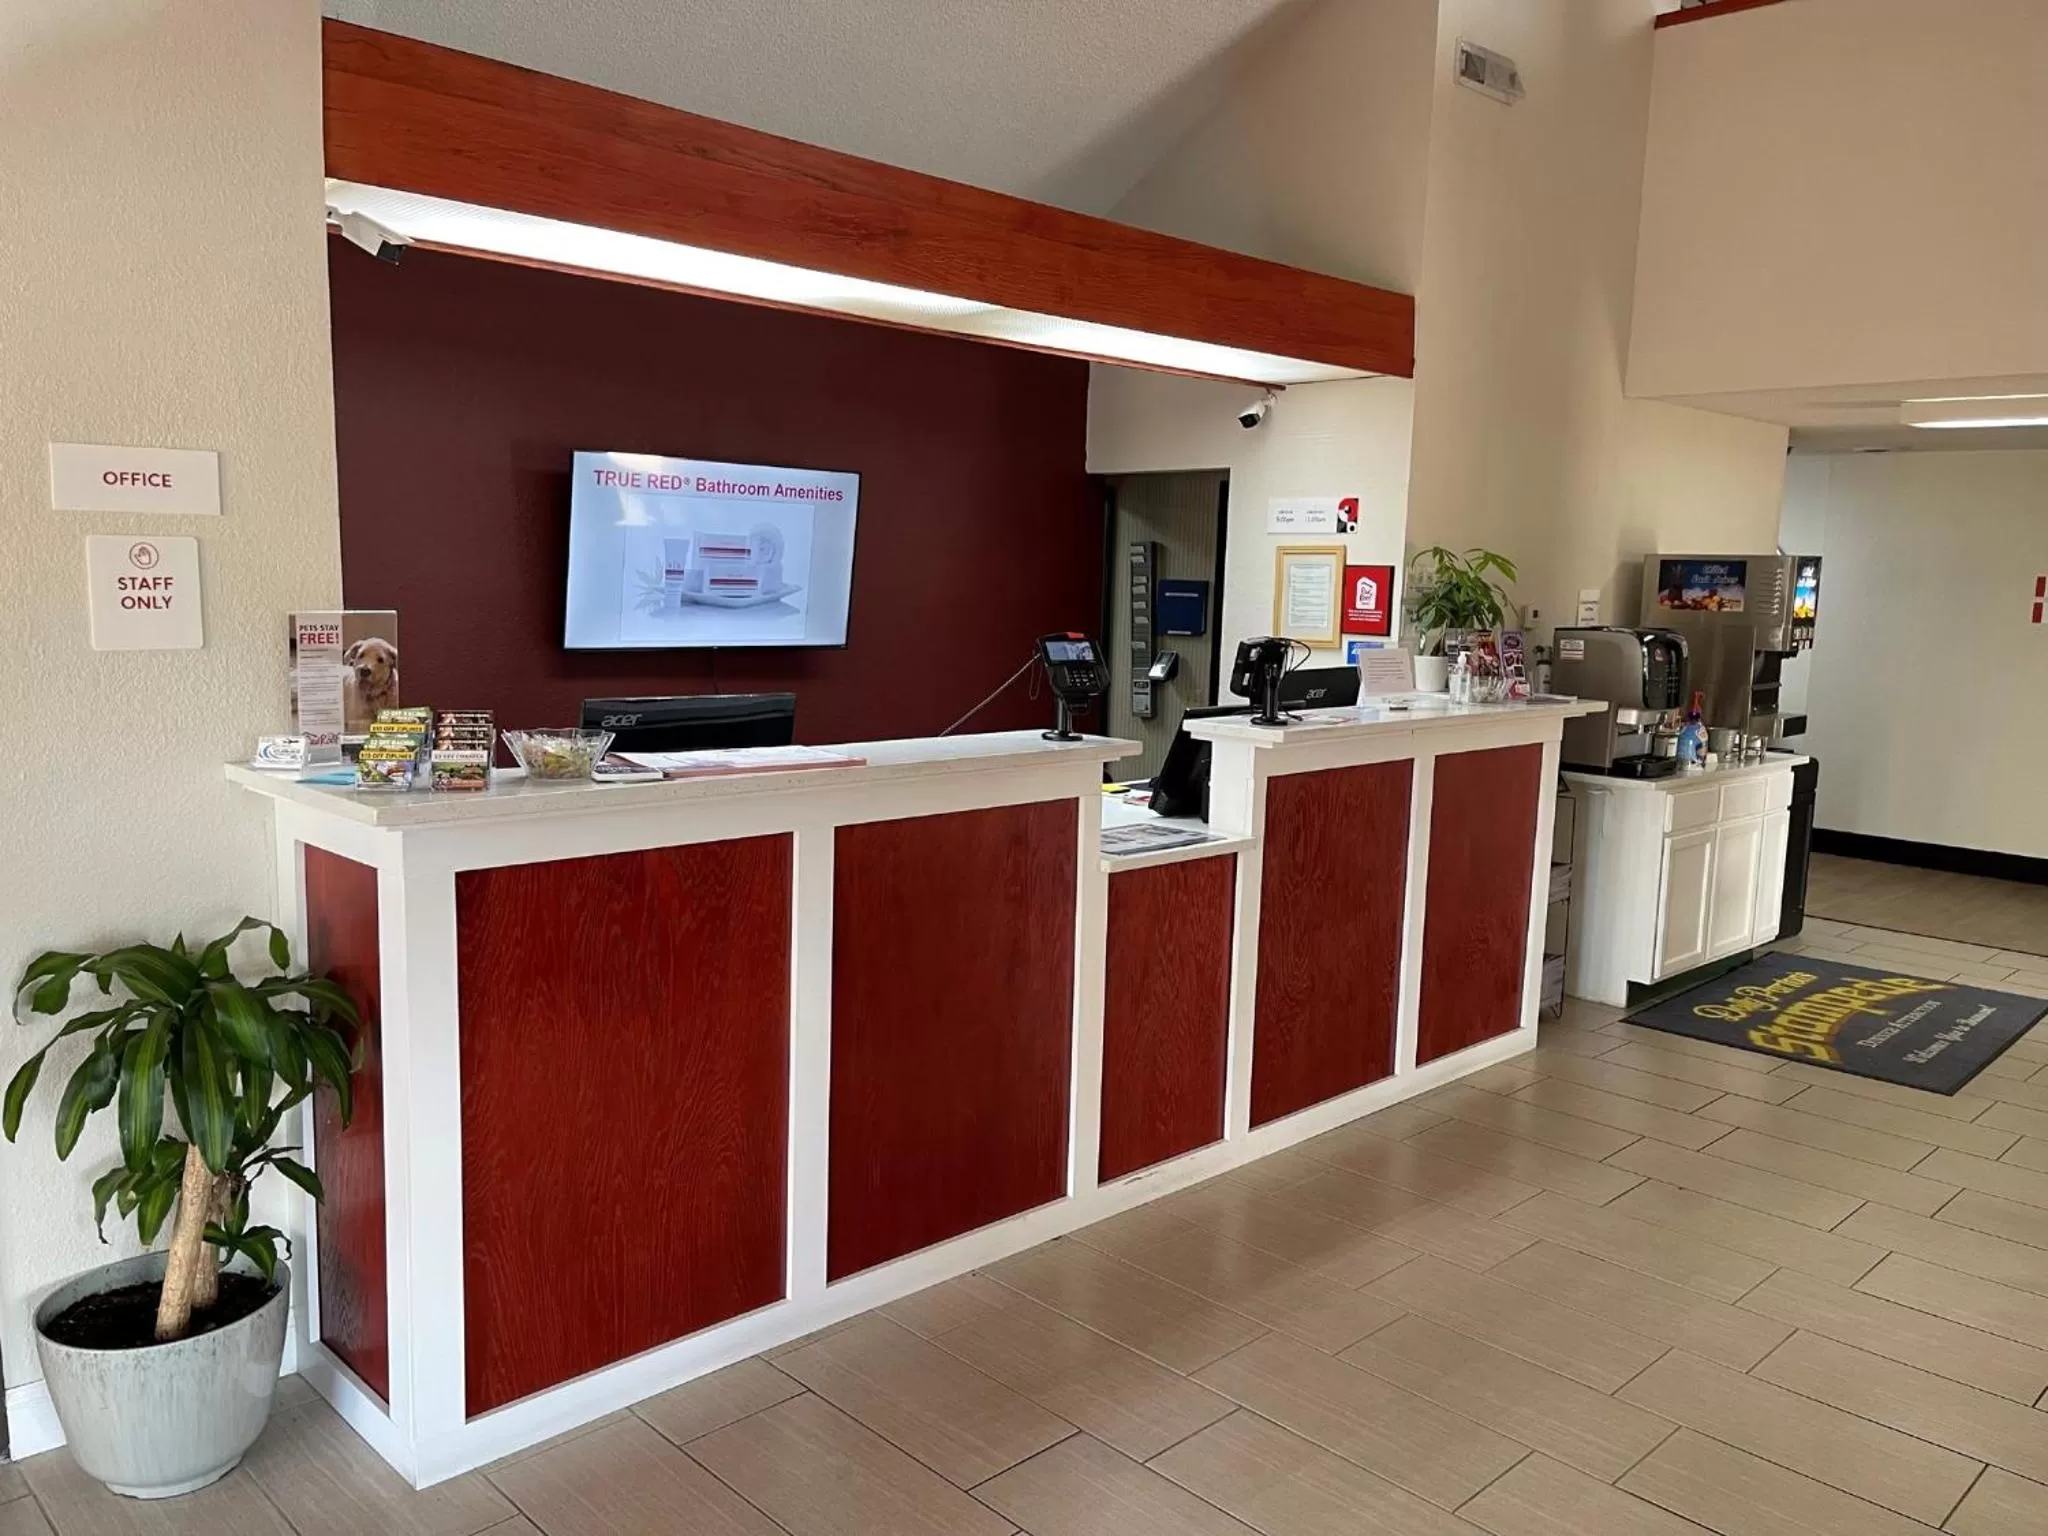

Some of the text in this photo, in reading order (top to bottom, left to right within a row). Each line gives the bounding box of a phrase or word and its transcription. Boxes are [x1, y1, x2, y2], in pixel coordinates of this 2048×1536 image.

[103, 471, 172, 488] OFFICE
[594, 470, 641, 488] TRUE
[696, 478, 770, 497] Bathroom
[774, 483, 844, 501] Amenities
[118, 577, 174, 591] STAFF
[121, 596, 172, 610] ONLY
[300, 633, 339, 645] FREE!
[1306, 688, 1328, 699] acer
[601, 713, 643, 727] acer
[1749, 977, 1955, 1064] Stampede
